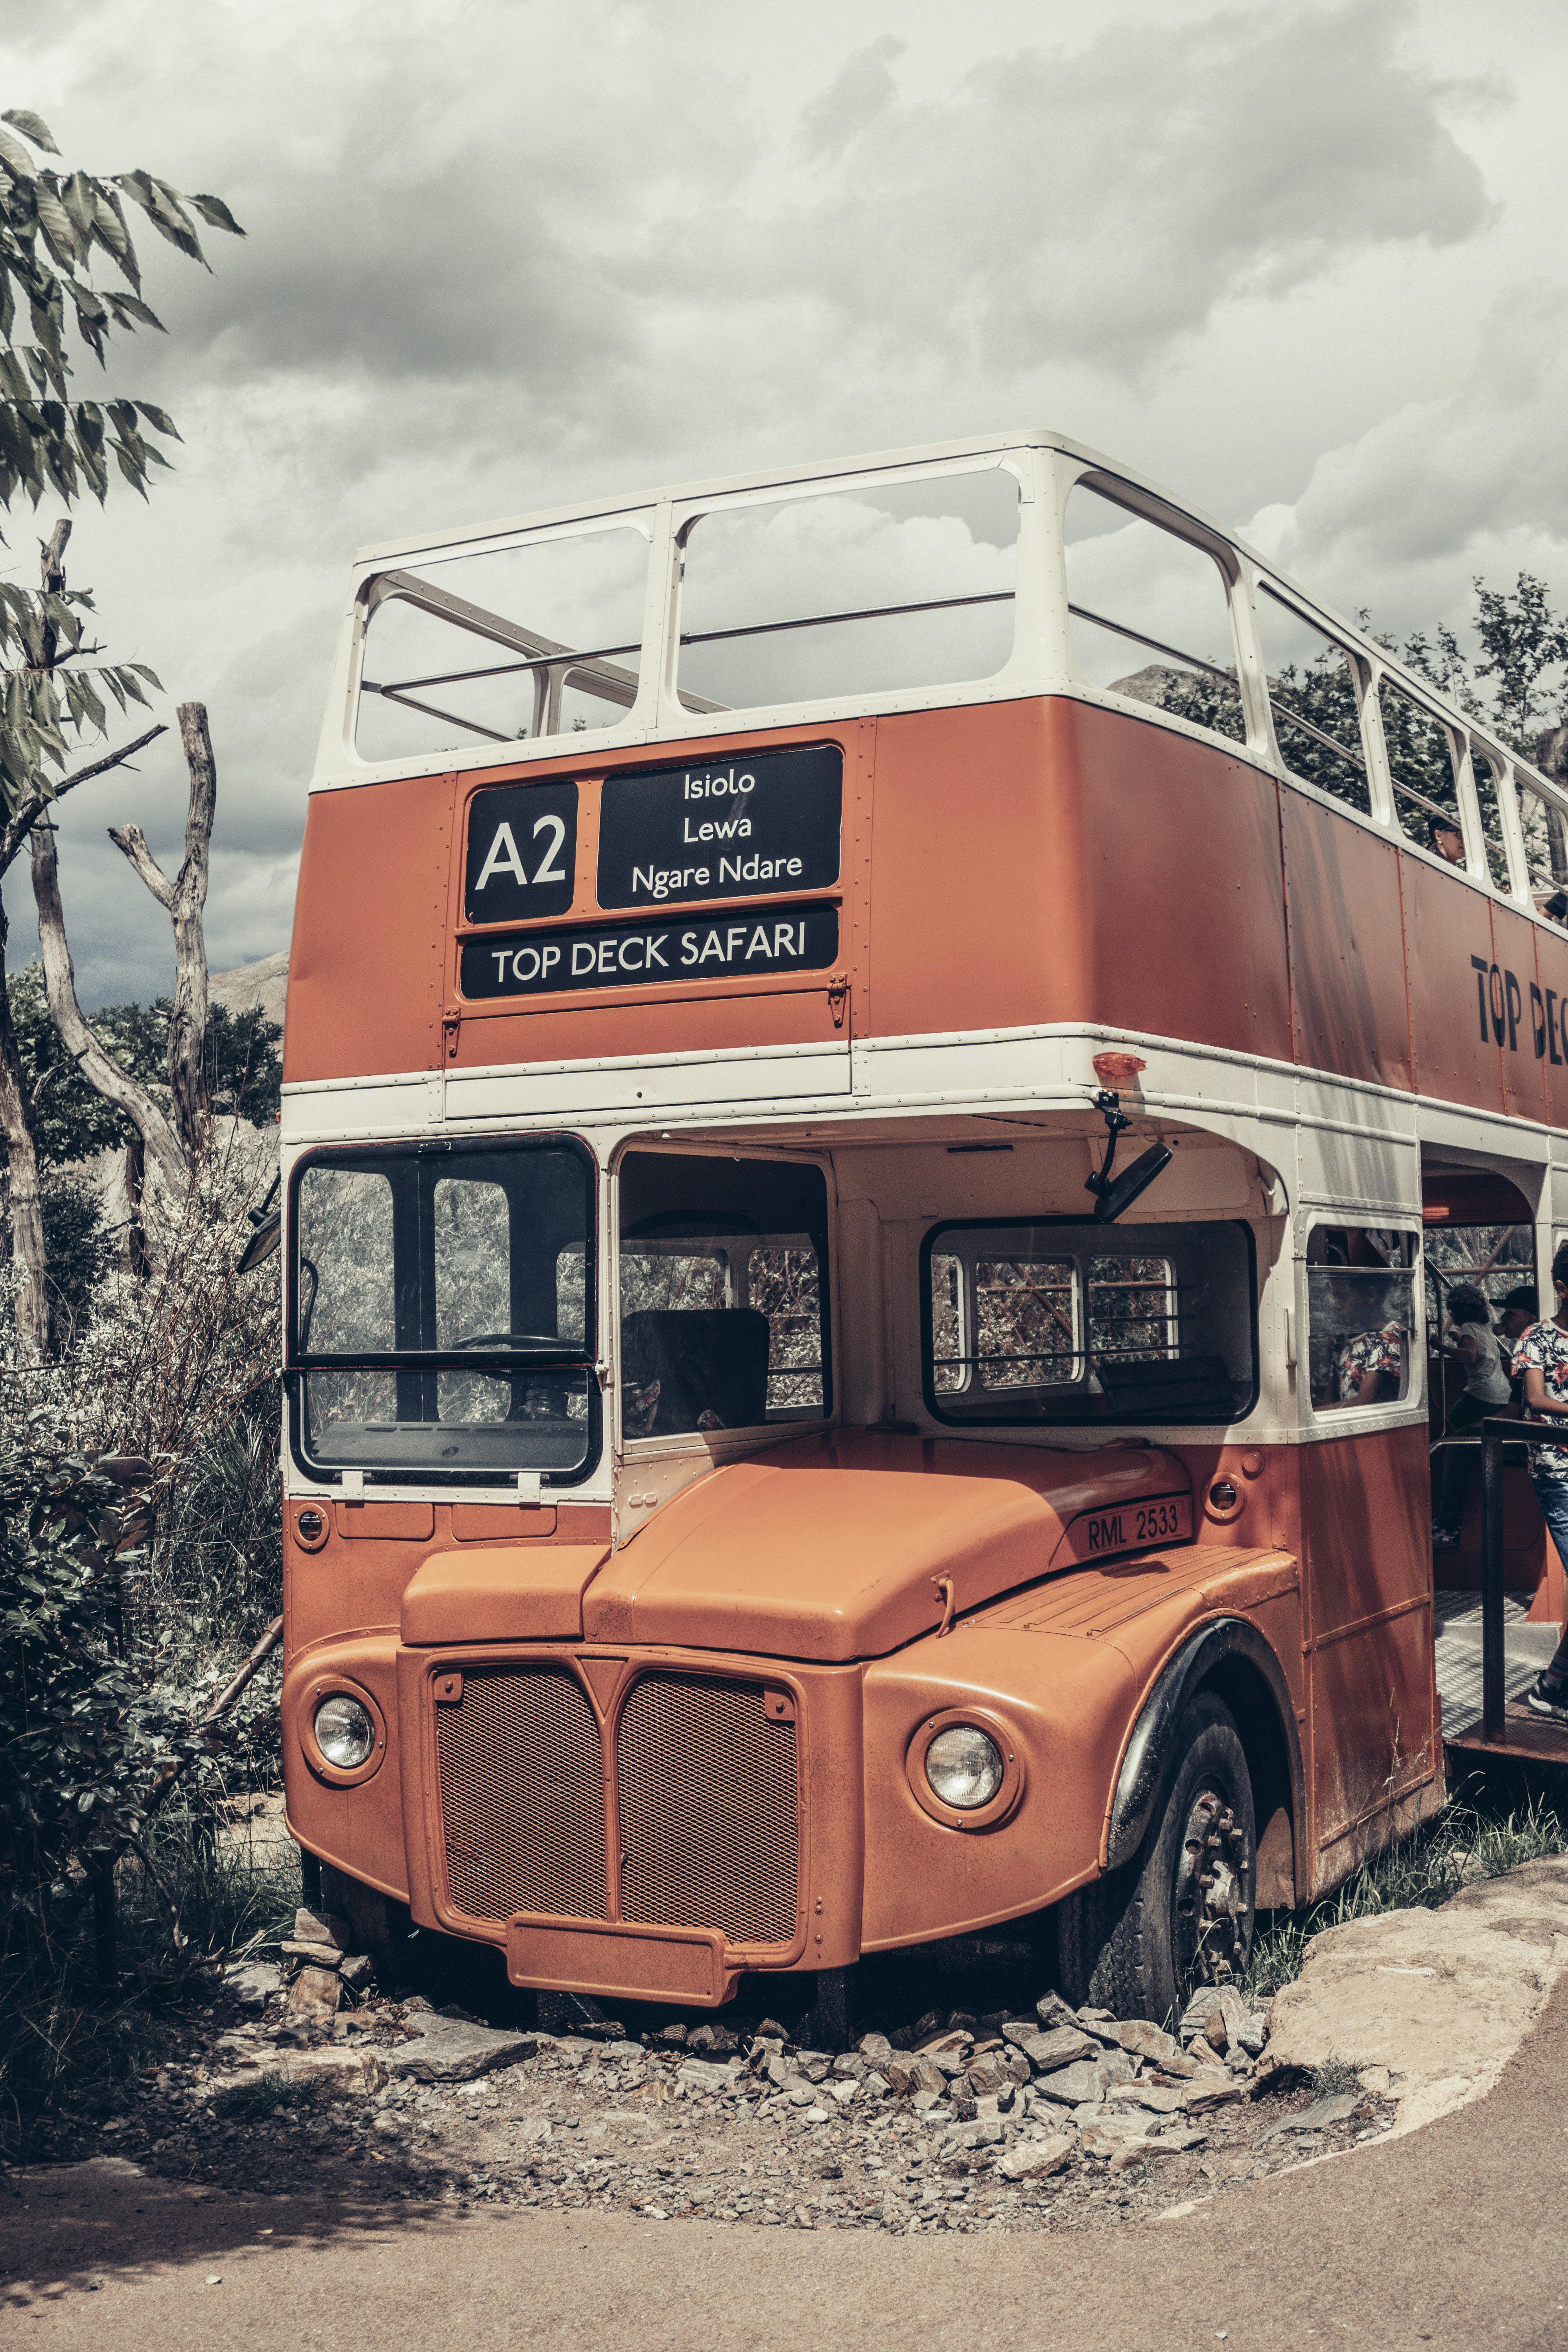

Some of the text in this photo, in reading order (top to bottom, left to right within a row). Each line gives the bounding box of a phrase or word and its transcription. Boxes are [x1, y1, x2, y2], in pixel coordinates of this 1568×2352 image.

[684, 769, 755, 800] Isiolo
[475, 815, 566, 890] A2
[684, 817, 751, 843] Lewa
[632, 853, 802, 898] Ngare Ndare
[492, 922, 805, 982] TOP DECK SAFARI
[1470, 954, 1522, 1052] TOP
[1089, 1504, 1178, 1550] RML 2533
